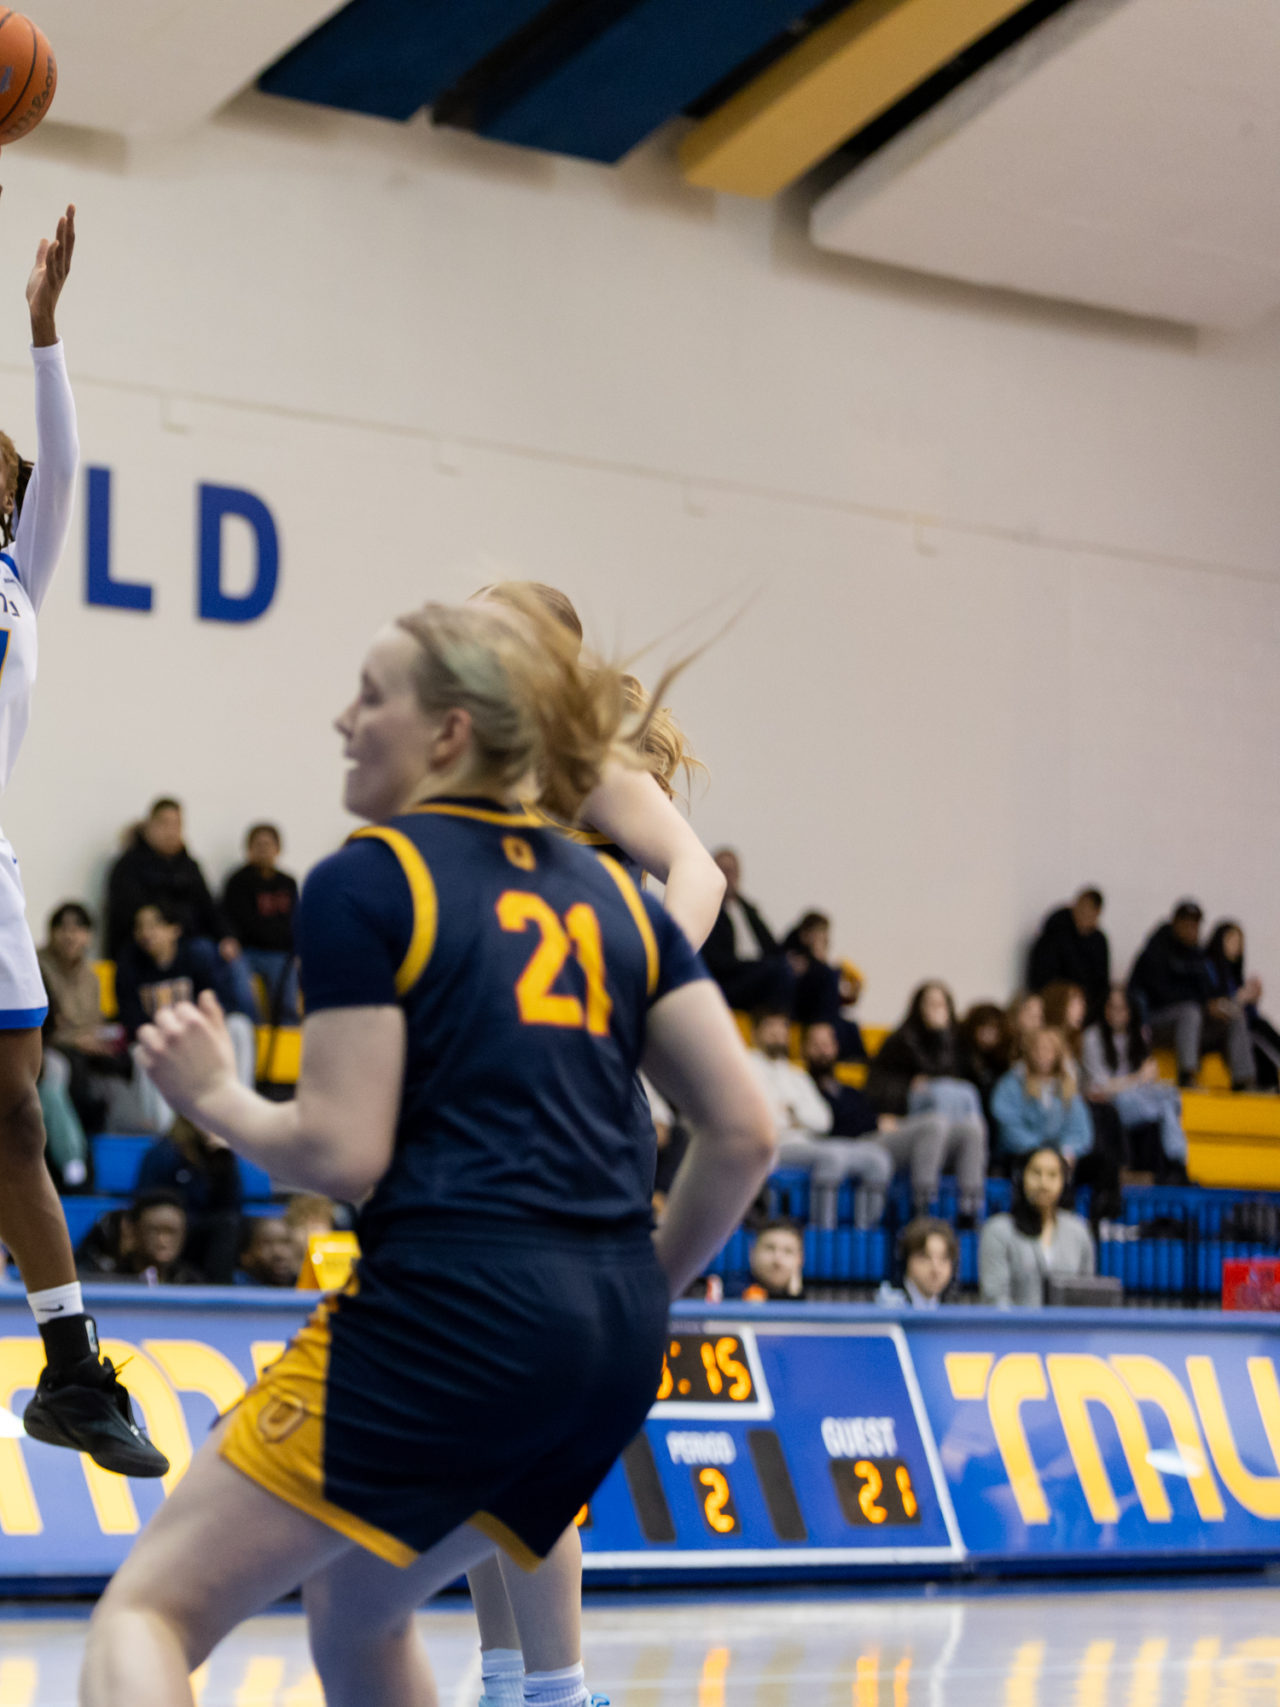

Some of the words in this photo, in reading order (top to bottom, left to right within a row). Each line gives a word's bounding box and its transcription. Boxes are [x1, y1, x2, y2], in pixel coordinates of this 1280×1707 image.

[495, 889, 613, 1038] 21
[666, 1430, 738, 1466] PERIOD
[821, 1415, 898, 1459] GUEST
[944, 1352, 1280, 1525] TMU
[699, 1467, 736, 1534] 2
[853, 1460, 918, 1525] 21
